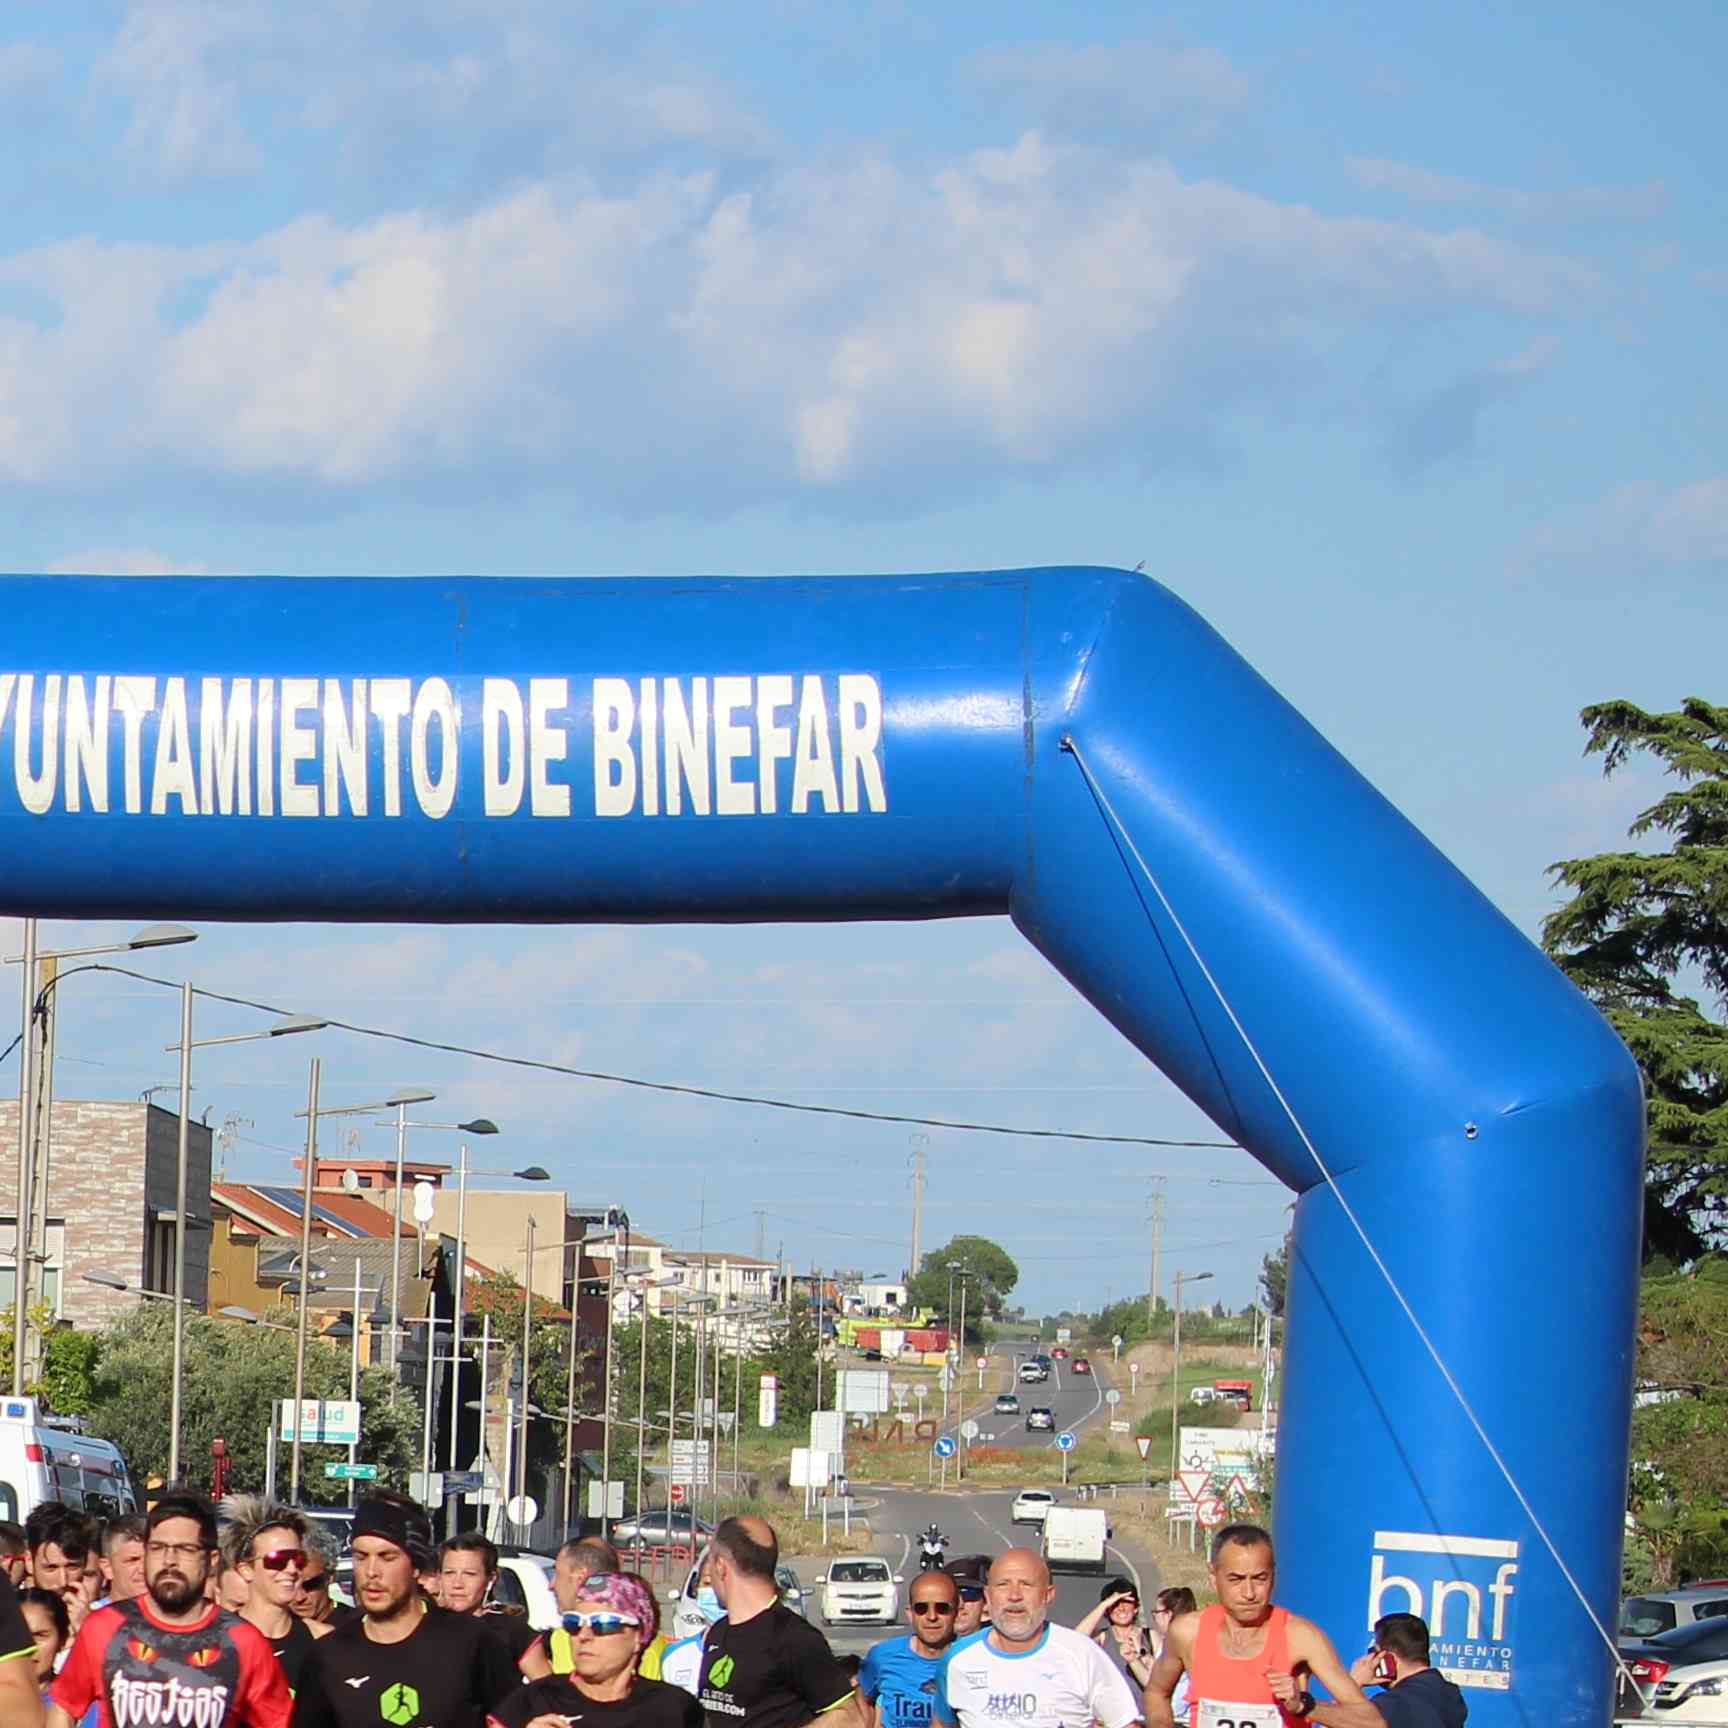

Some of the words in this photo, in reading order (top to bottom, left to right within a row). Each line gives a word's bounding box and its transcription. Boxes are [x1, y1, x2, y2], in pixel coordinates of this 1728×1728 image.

[483, 676, 572, 818] DE
[592, 673, 887, 816] BINEFAR
[1368, 1555, 1520, 1641] bnf
